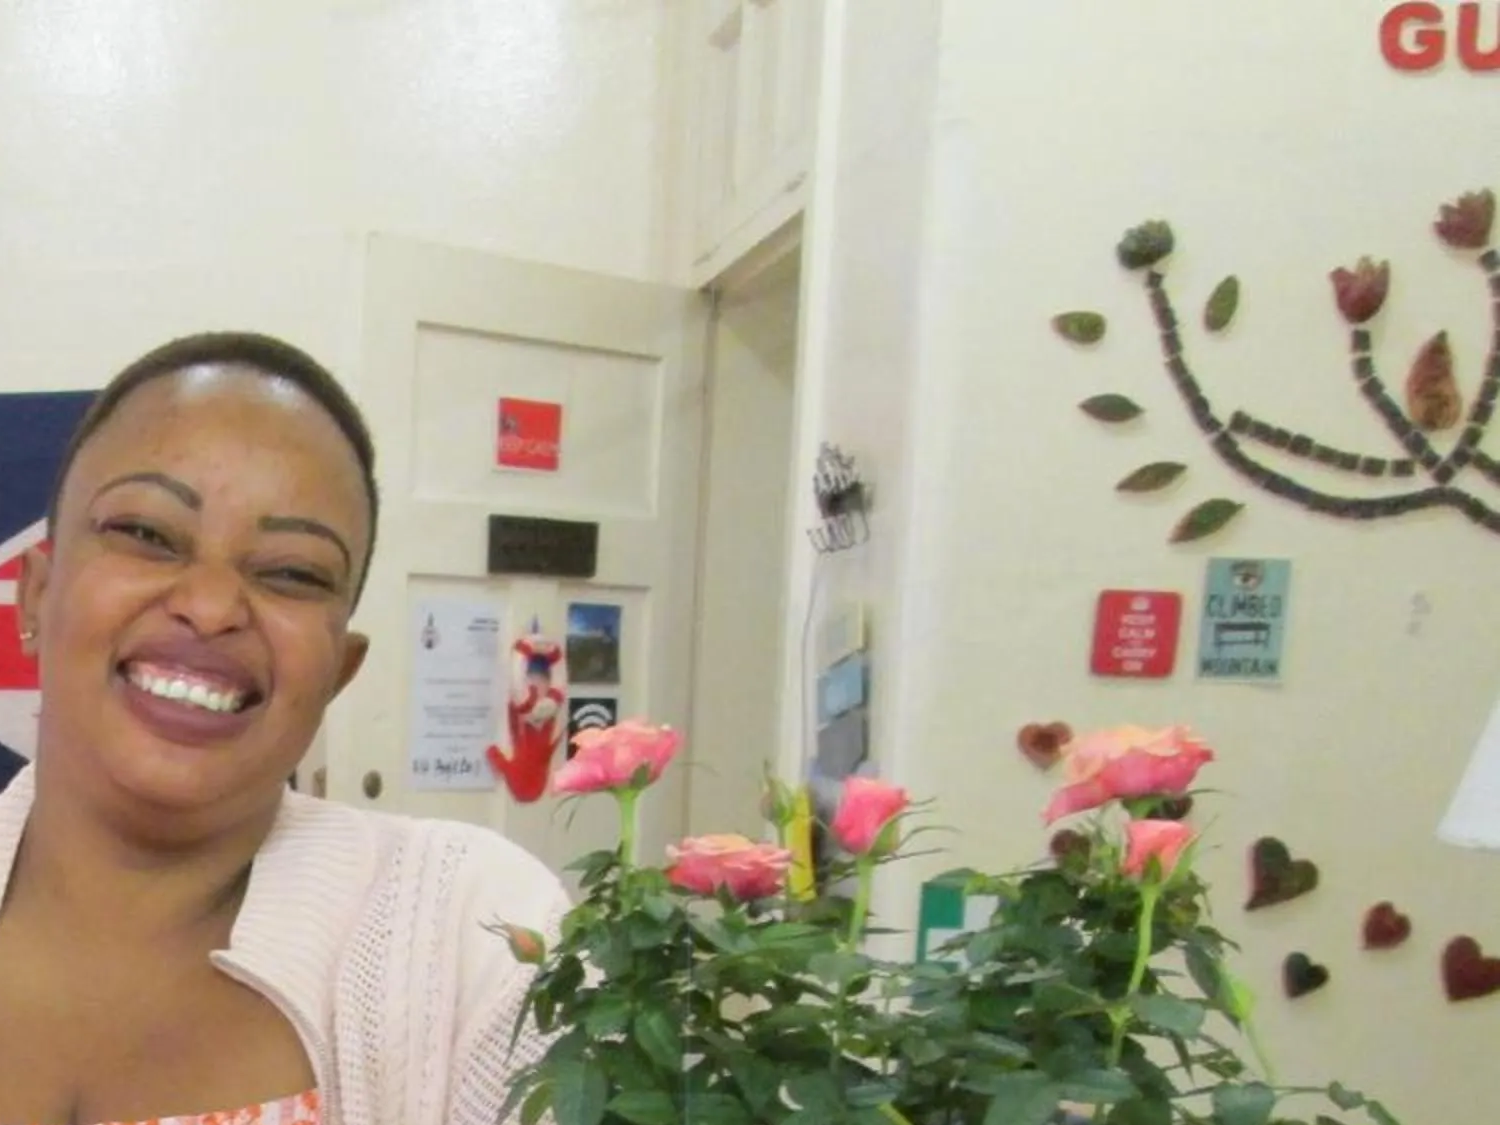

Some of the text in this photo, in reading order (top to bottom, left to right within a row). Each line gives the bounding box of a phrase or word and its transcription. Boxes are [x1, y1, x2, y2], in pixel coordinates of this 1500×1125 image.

[1379, 1, 1500, 72] GU
[1207, 594, 1282, 618] CLIMBED
[1118, 627, 1156, 639] CALM
[1201, 658, 1278, 677] MOUNTAIN
